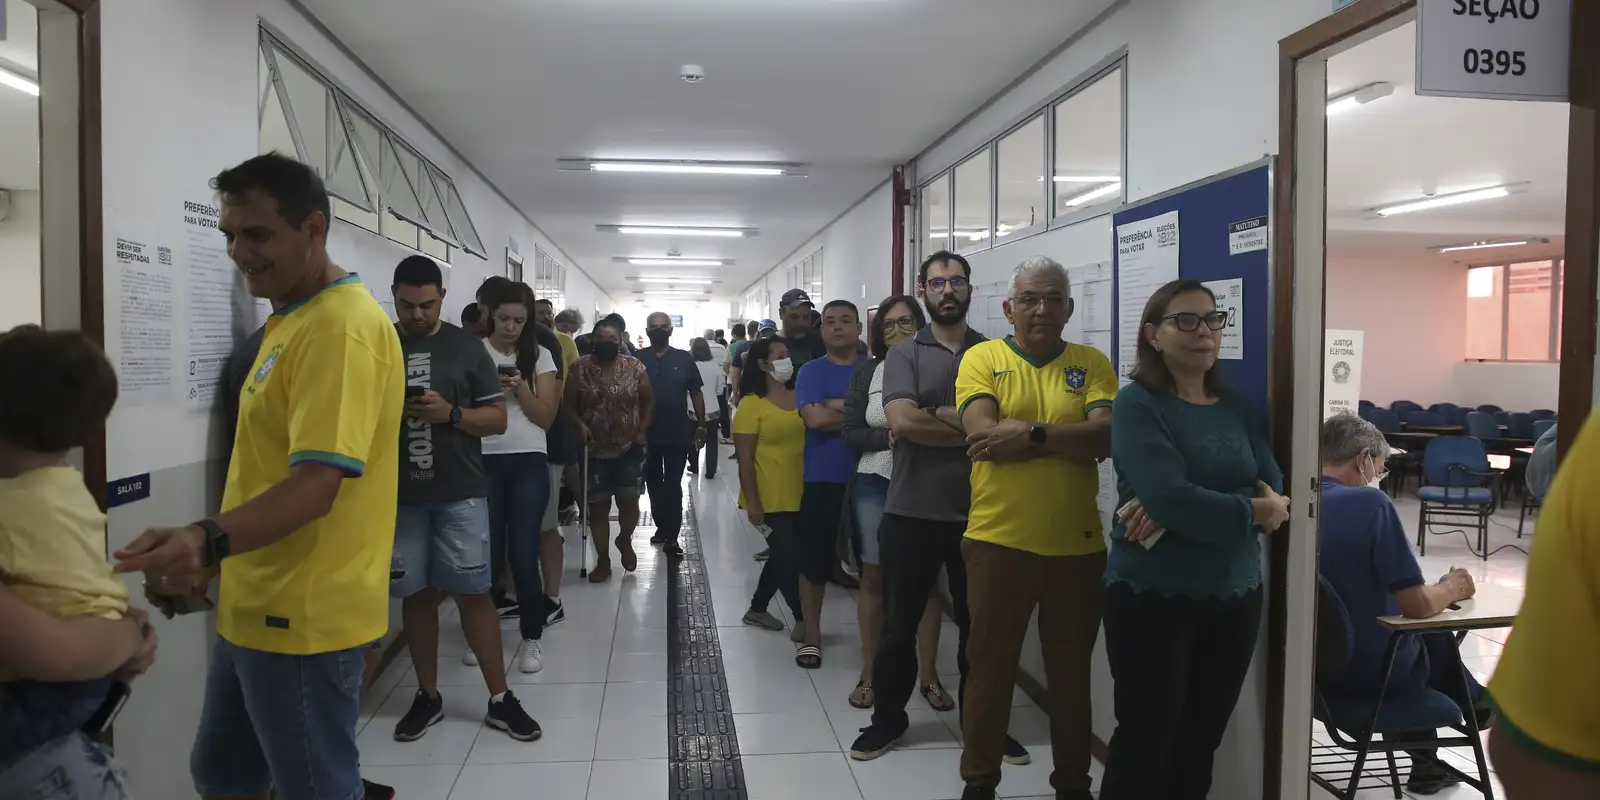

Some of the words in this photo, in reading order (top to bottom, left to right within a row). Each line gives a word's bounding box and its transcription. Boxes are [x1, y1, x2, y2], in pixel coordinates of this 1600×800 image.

[1463, 48, 1526, 76] 0395
[184, 215, 197, 225] PARA
[198, 217, 218, 229] VOTAR
[1235, 219, 1260, 231] MATUTINO
[1119, 229, 1153, 244] PREFERÊNCIA
[1130, 242, 1145, 253] VOTAR
[1333, 339, 1353, 347] JUSTIÇA
[1329, 348, 1355, 356] ELEITORAL
[407, 417, 434, 469] STOP
[117, 483, 133, 495] SALA
